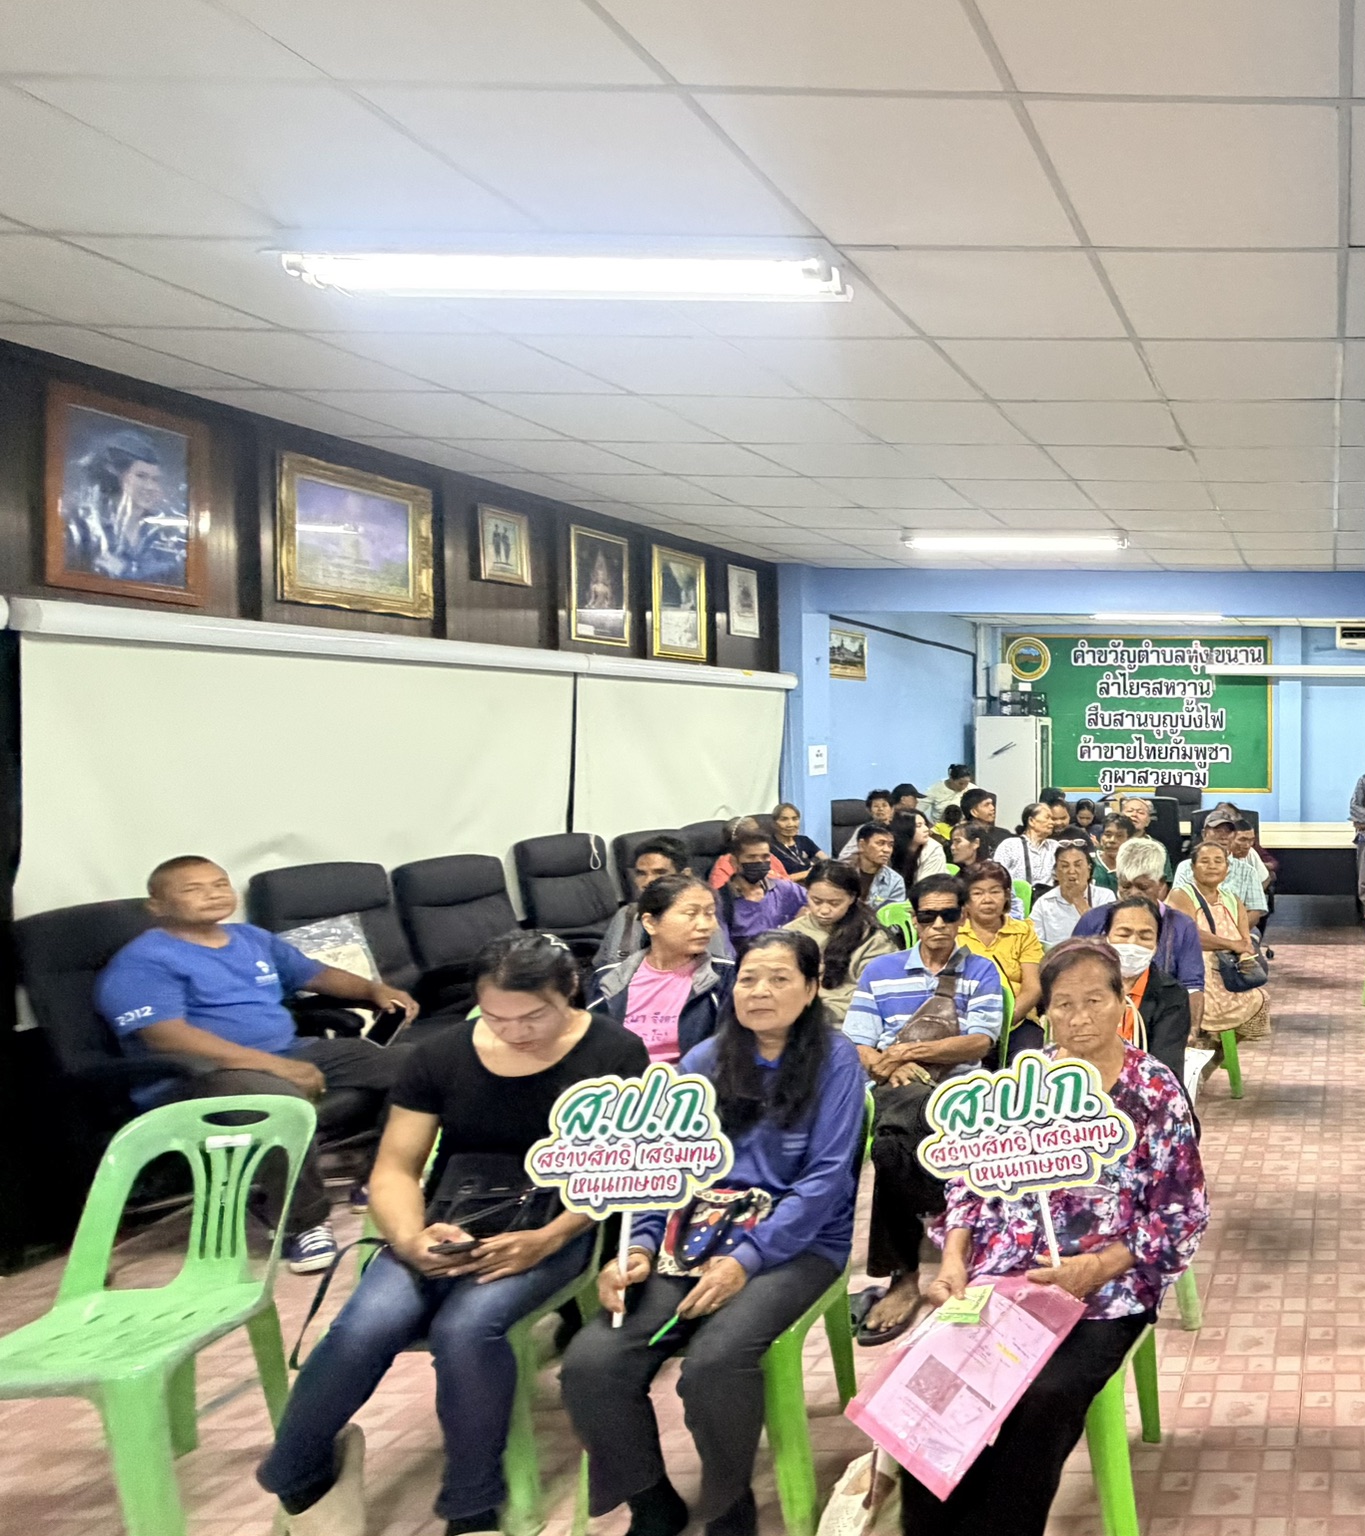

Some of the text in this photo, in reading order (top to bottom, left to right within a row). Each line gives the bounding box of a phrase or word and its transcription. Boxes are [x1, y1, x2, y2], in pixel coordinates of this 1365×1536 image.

[1098, 672, 1211, 696] ลำไยรสหวาน
[1087, 699, 1224, 735] สืบสานบุญบั้งไฟ
[1079, 736, 1230, 768] ค้าขายไทยกัมพูชา
[1100, 768, 1207, 792] ภูผาสวยงาม
[562, 1074, 704, 1136] ส.ป.ก.
[939, 1063, 1095, 1132] ส.ป.ก.
[538, 1142, 717, 1170] สร้างสิทธิ เสริมทุน
[930, 1121, 1118, 1163] สร้างสิทธิ เสริมทุน
[974, 1153, 1083, 1186] หนุนเกษตร
[572, 1173, 677, 1201] หนุนเกษตร
